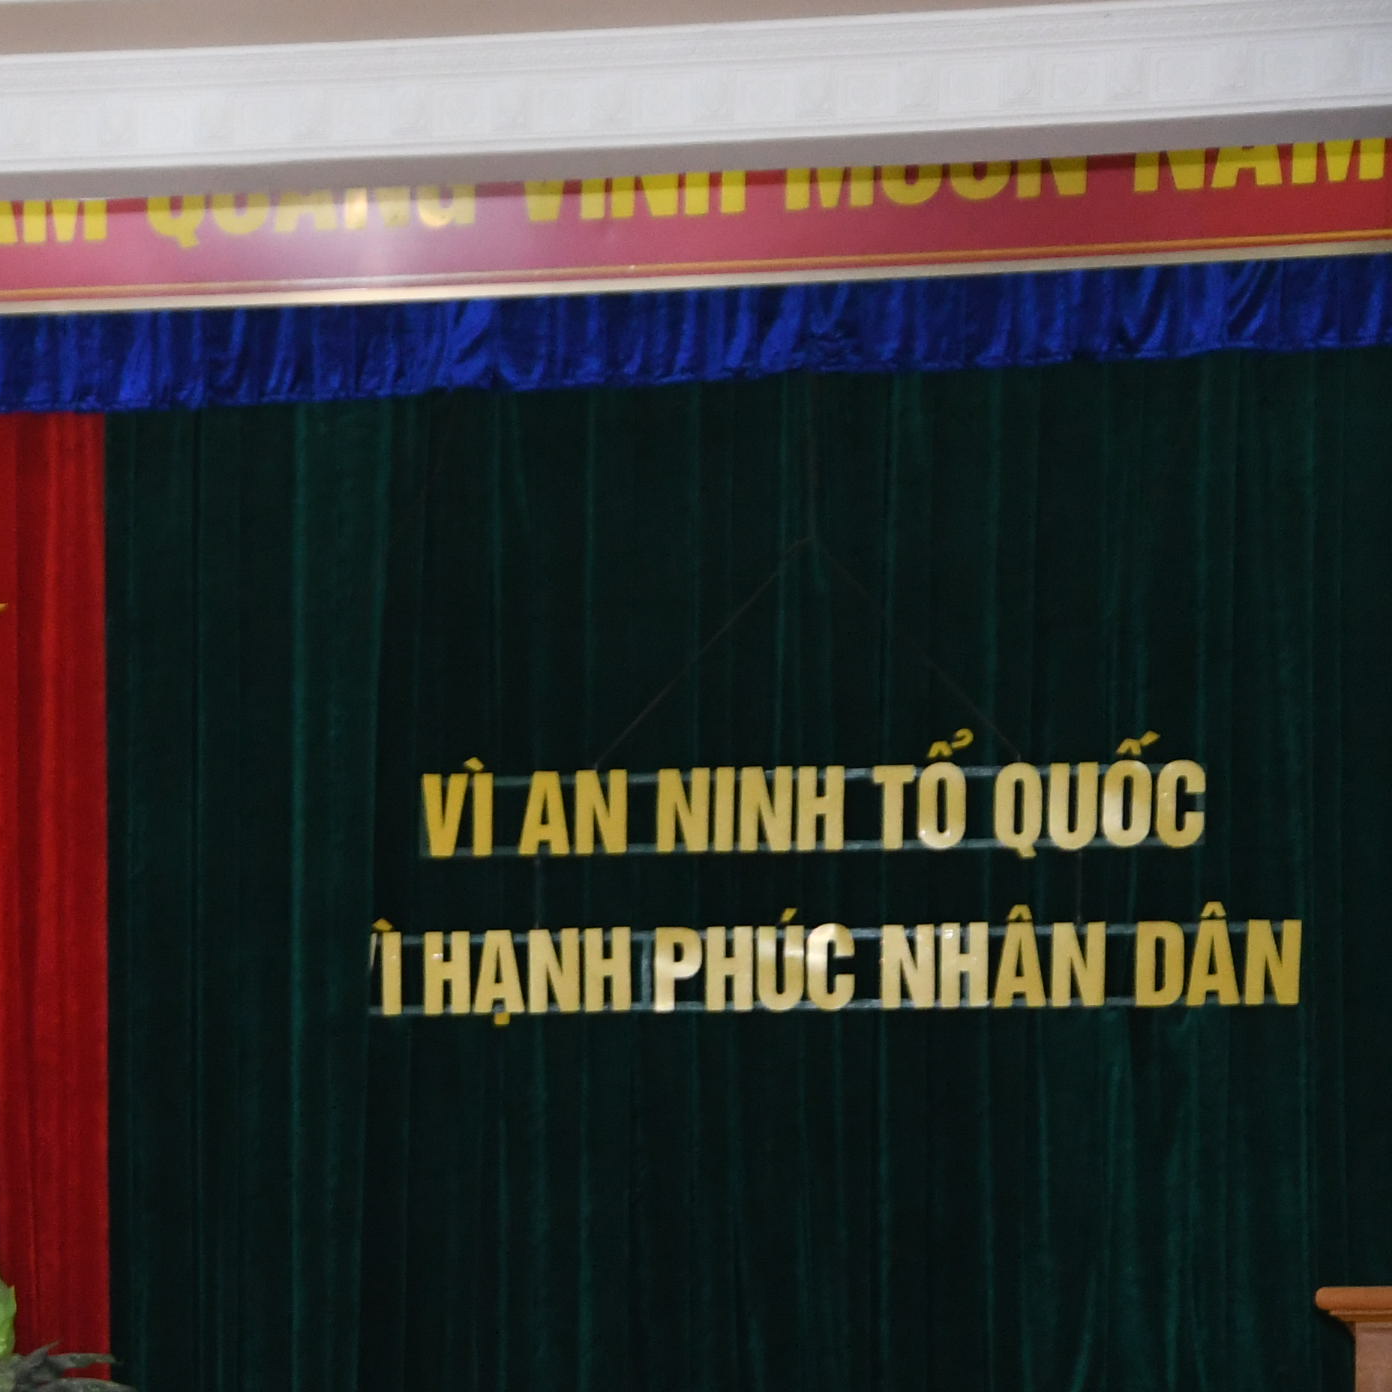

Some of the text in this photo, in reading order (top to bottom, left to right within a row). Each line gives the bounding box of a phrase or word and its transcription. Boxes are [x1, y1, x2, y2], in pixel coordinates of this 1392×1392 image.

[422, 728, 1207, 859] VÌ AN NINH TỔ QUỐC
[423, 926, 632, 1026] HẠNH
[653, 907, 855, 1015] PHÚC
[879, 903, 1108, 1010] NHÂN
[1134, 901, 1303, 1006] DÂN
